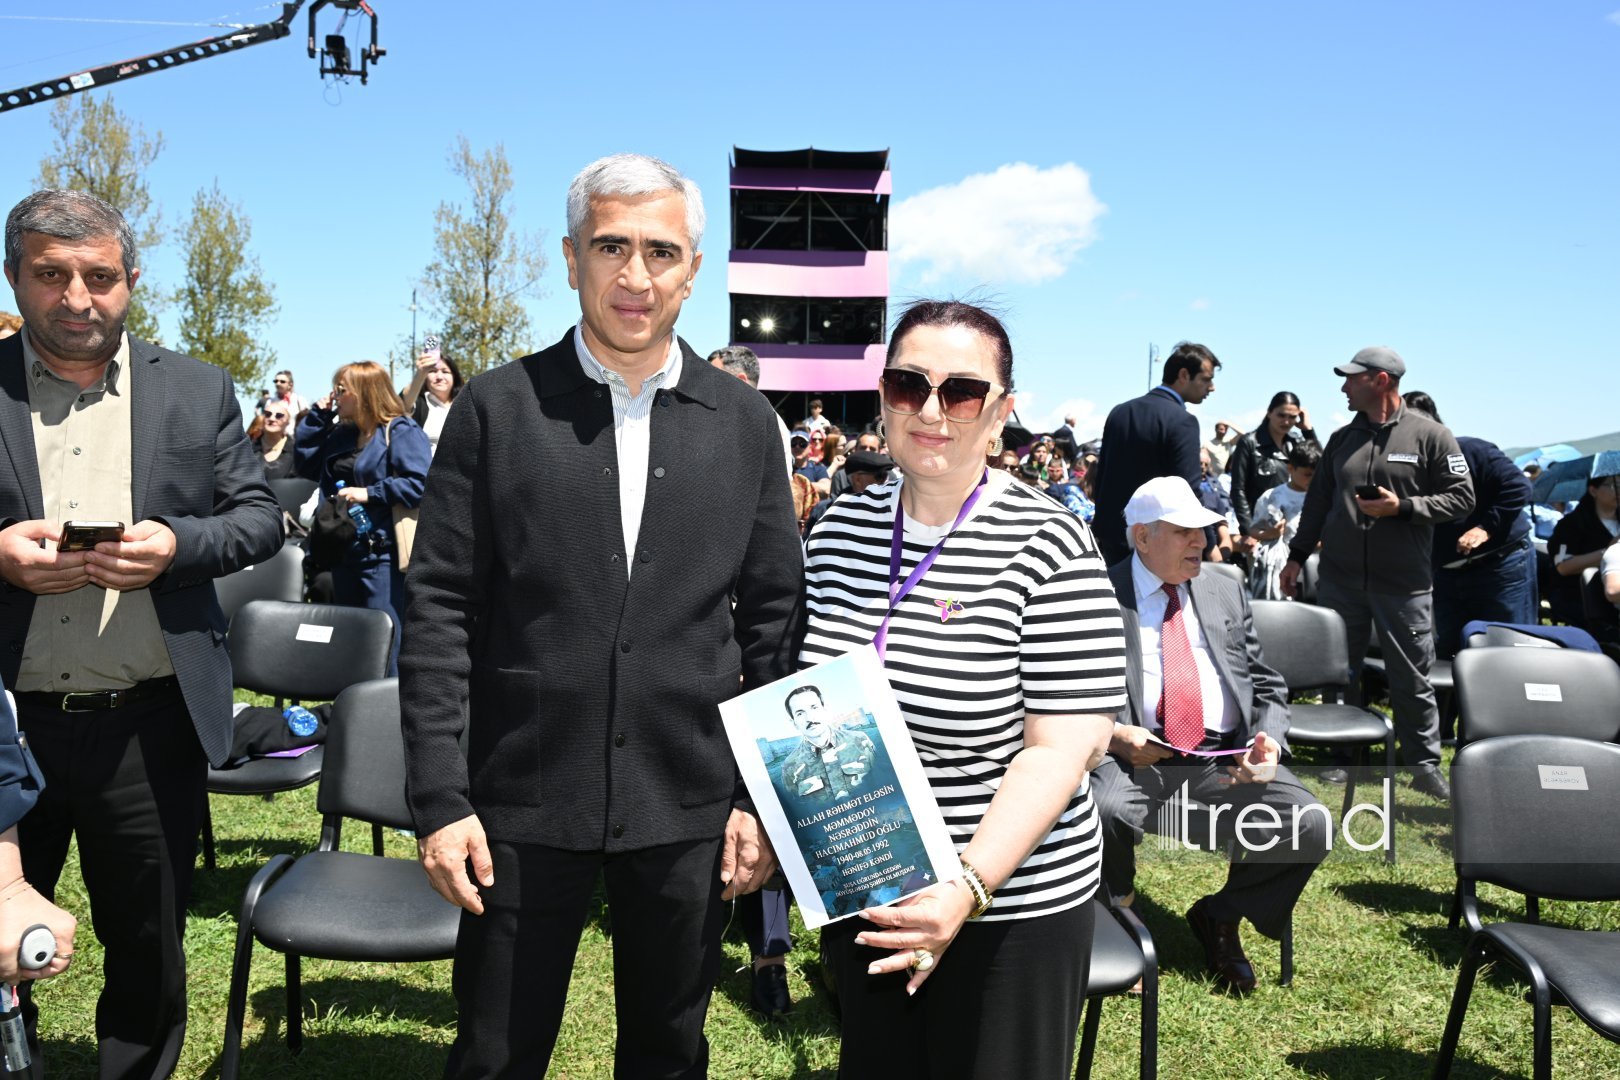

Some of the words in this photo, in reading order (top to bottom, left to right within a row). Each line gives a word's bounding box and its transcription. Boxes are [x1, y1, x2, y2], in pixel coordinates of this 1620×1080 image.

[797, 812, 825, 828] ALLAH
[826, 797, 862, 817] RƏHMƏT
[863, 784, 895, 802] ELƏSİN
[823, 806, 875, 833] MƏMMƏDOV
[829, 817, 879, 842] NƏSRƏDDİN
[815, 832, 875, 858] HACIMAHMUD
[876, 821, 901, 835] OĞLU
[837, 839, 890, 865] 1940-08.05.1992
[842, 862, 869, 876] HƏNİFƏ
[869, 851, 893, 866] KƏNDİ
